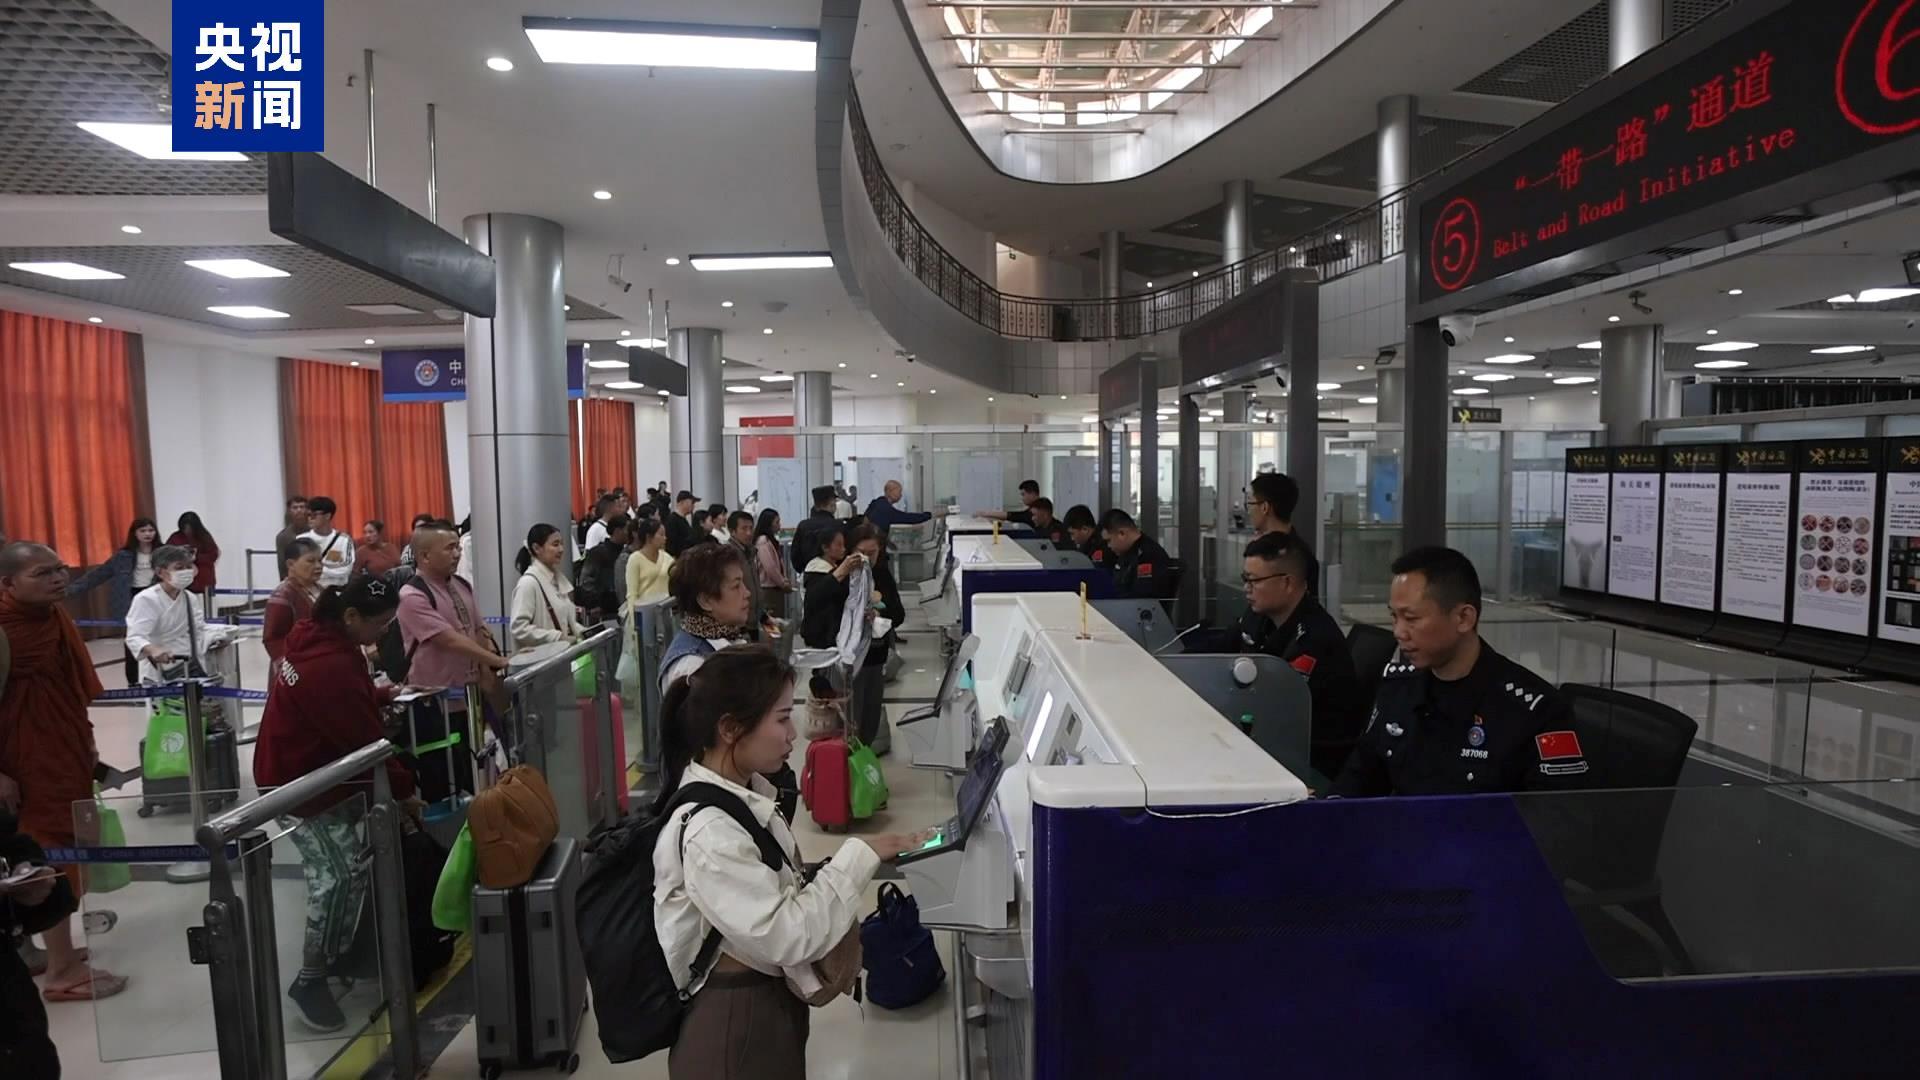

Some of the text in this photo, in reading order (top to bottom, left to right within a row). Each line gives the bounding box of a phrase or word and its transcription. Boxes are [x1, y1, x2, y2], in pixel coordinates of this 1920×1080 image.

[1493, 127, 1796, 258] Belt and Road Initiative
[449, 360, 462, 375] 中
[1460, 748, 1489, 759] 387068
